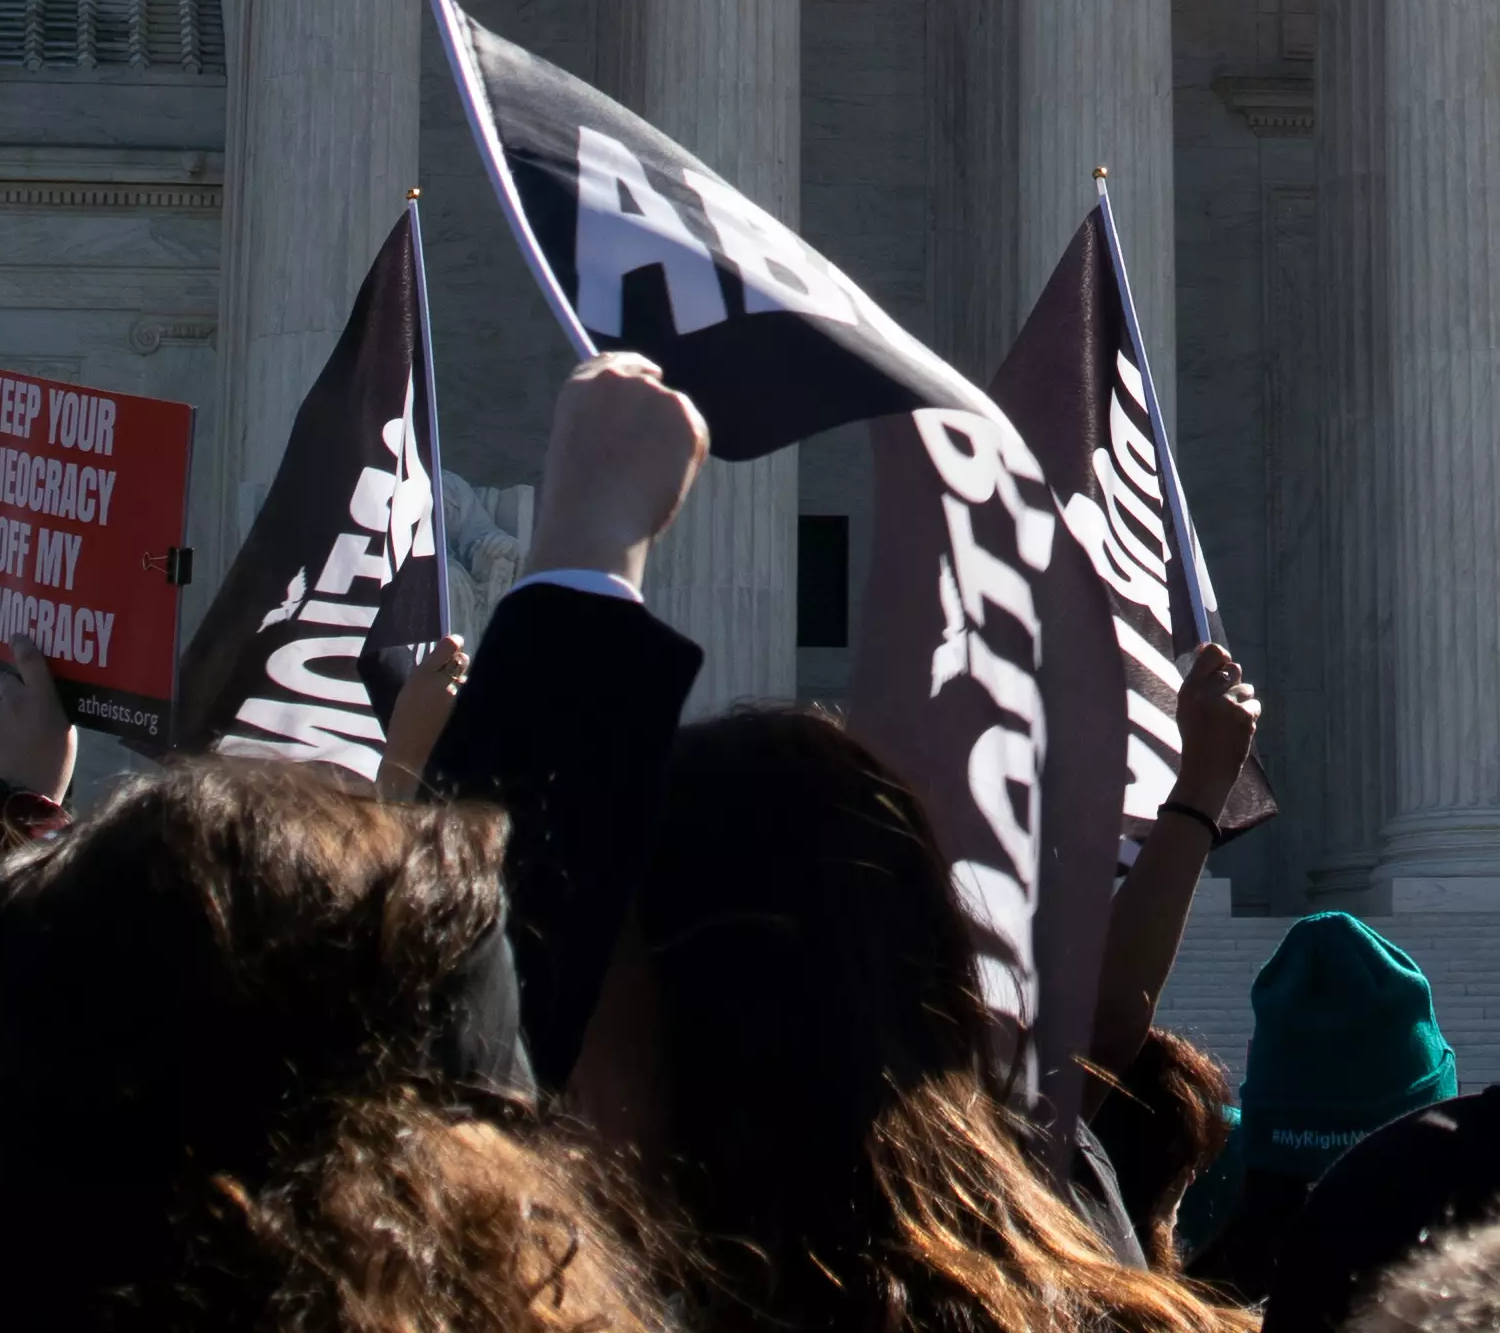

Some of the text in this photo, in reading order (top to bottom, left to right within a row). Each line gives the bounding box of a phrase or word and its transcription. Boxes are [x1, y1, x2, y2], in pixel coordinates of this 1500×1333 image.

[48, 388, 117, 456] YOUR
[35, 527, 83, 591] MY
[78, 695, 159, 735] atheists.org
